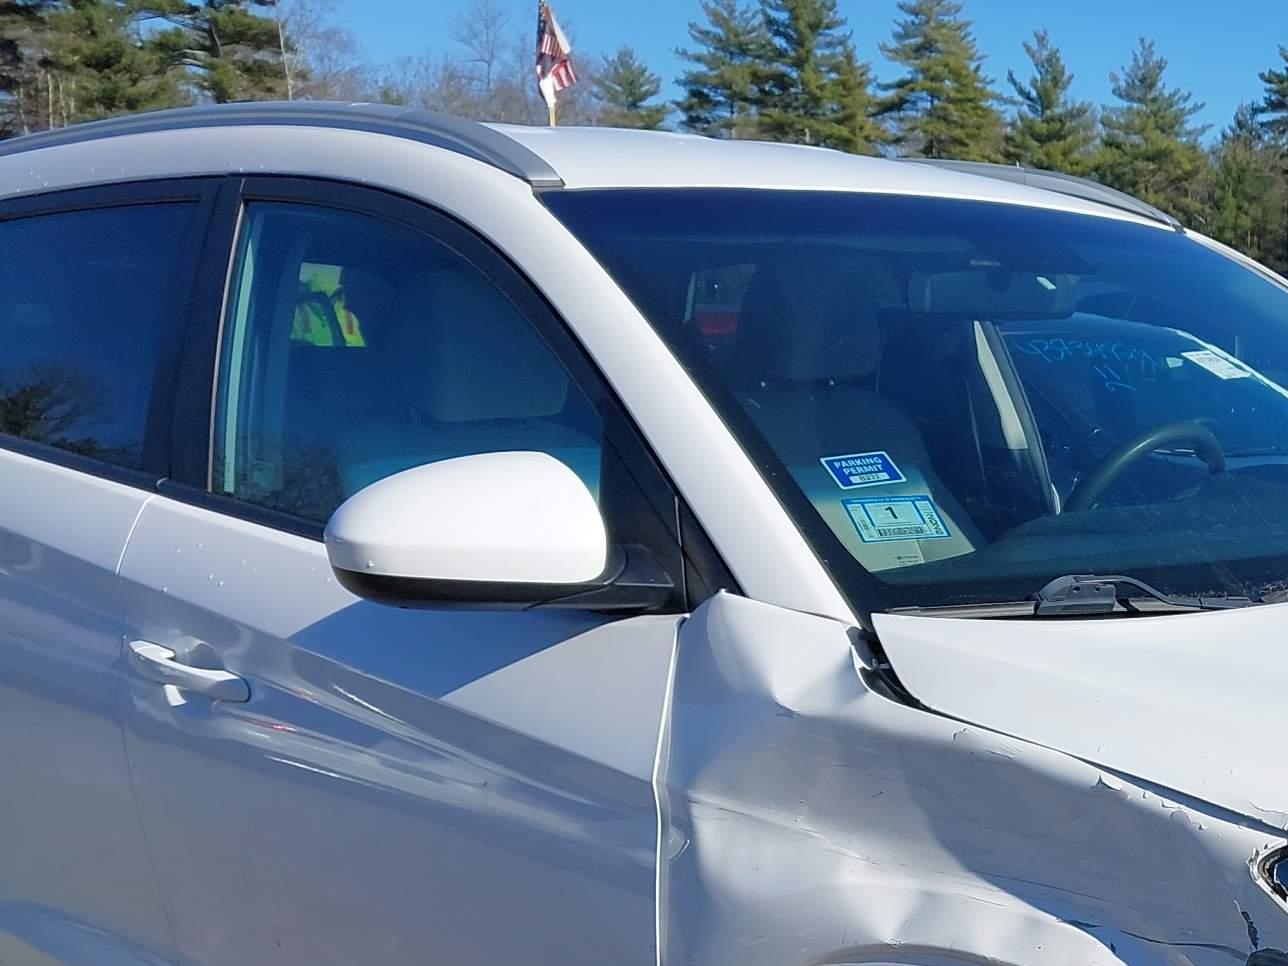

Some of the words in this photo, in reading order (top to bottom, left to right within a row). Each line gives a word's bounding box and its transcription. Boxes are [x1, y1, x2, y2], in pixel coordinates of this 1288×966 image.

[834, 457, 882, 468] PARKING
[842, 464, 884, 475] PERMIT
[884, 506, 898, 520] 1
